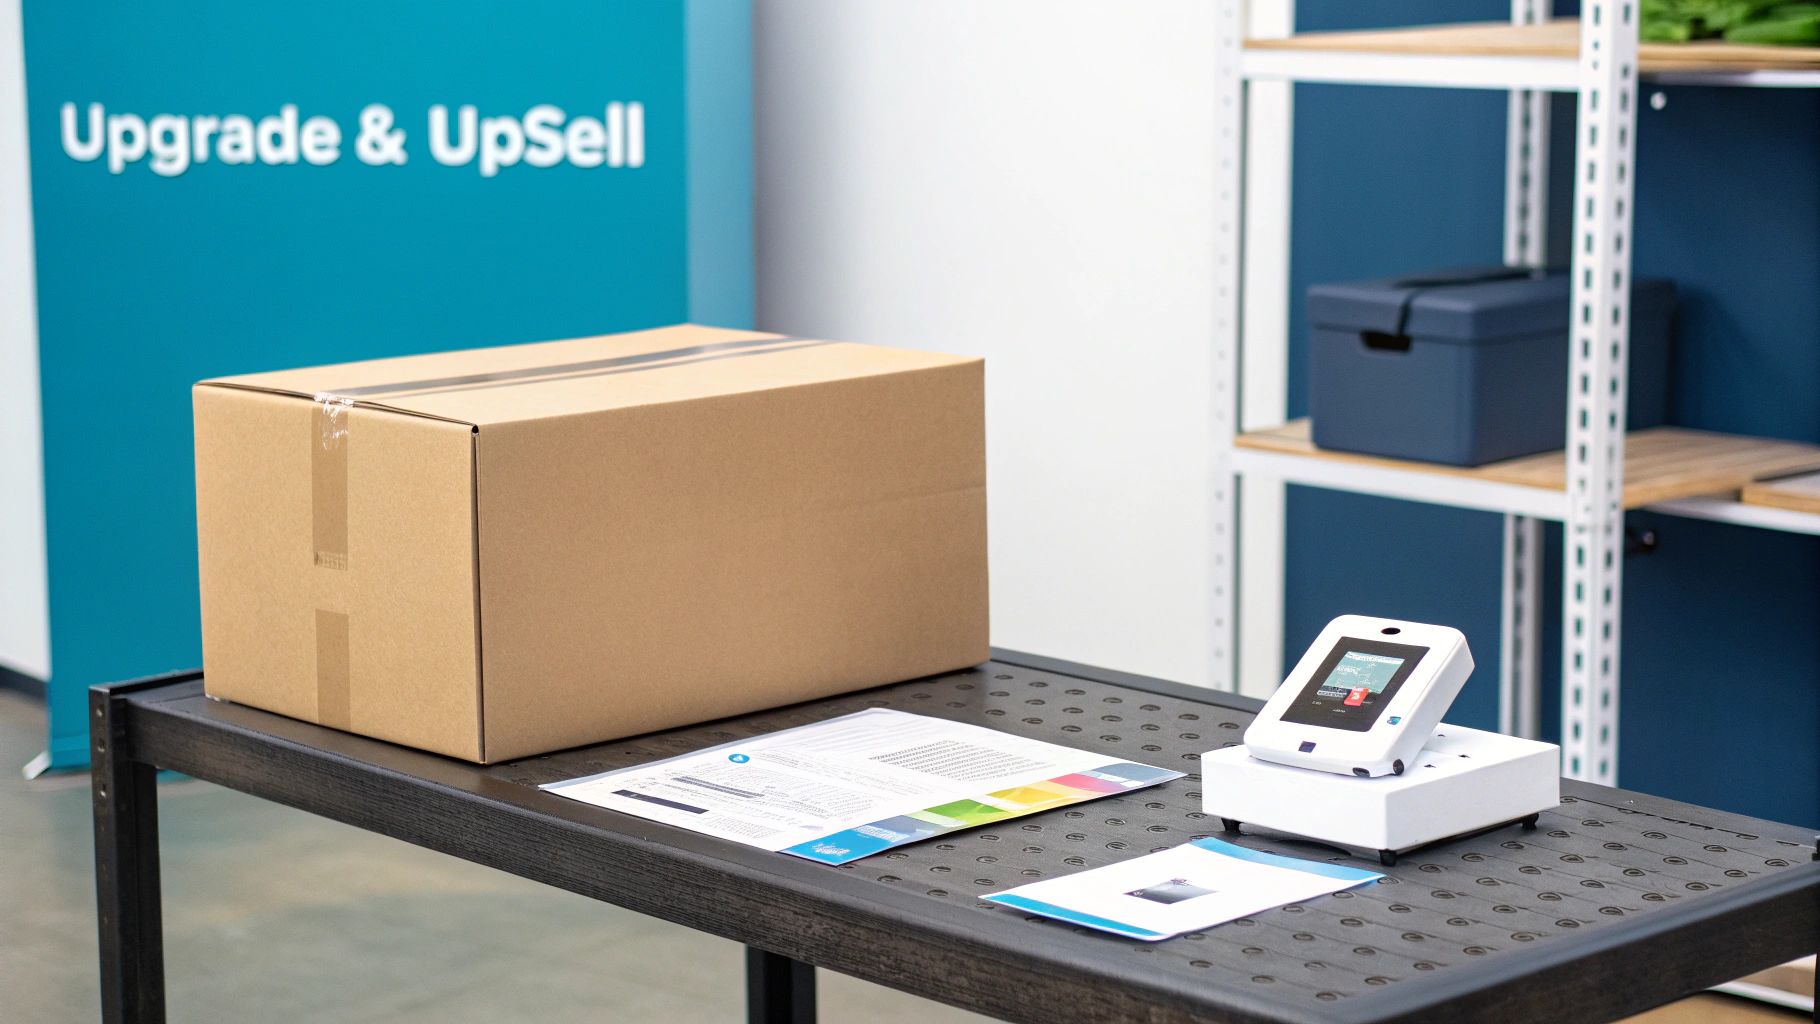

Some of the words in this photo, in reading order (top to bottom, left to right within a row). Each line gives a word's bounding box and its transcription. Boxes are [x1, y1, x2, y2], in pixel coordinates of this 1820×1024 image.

[60, 103, 342, 177] Upgrade
[355, 103, 408, 166] &
[428, 101, 645, 177] UpSell
